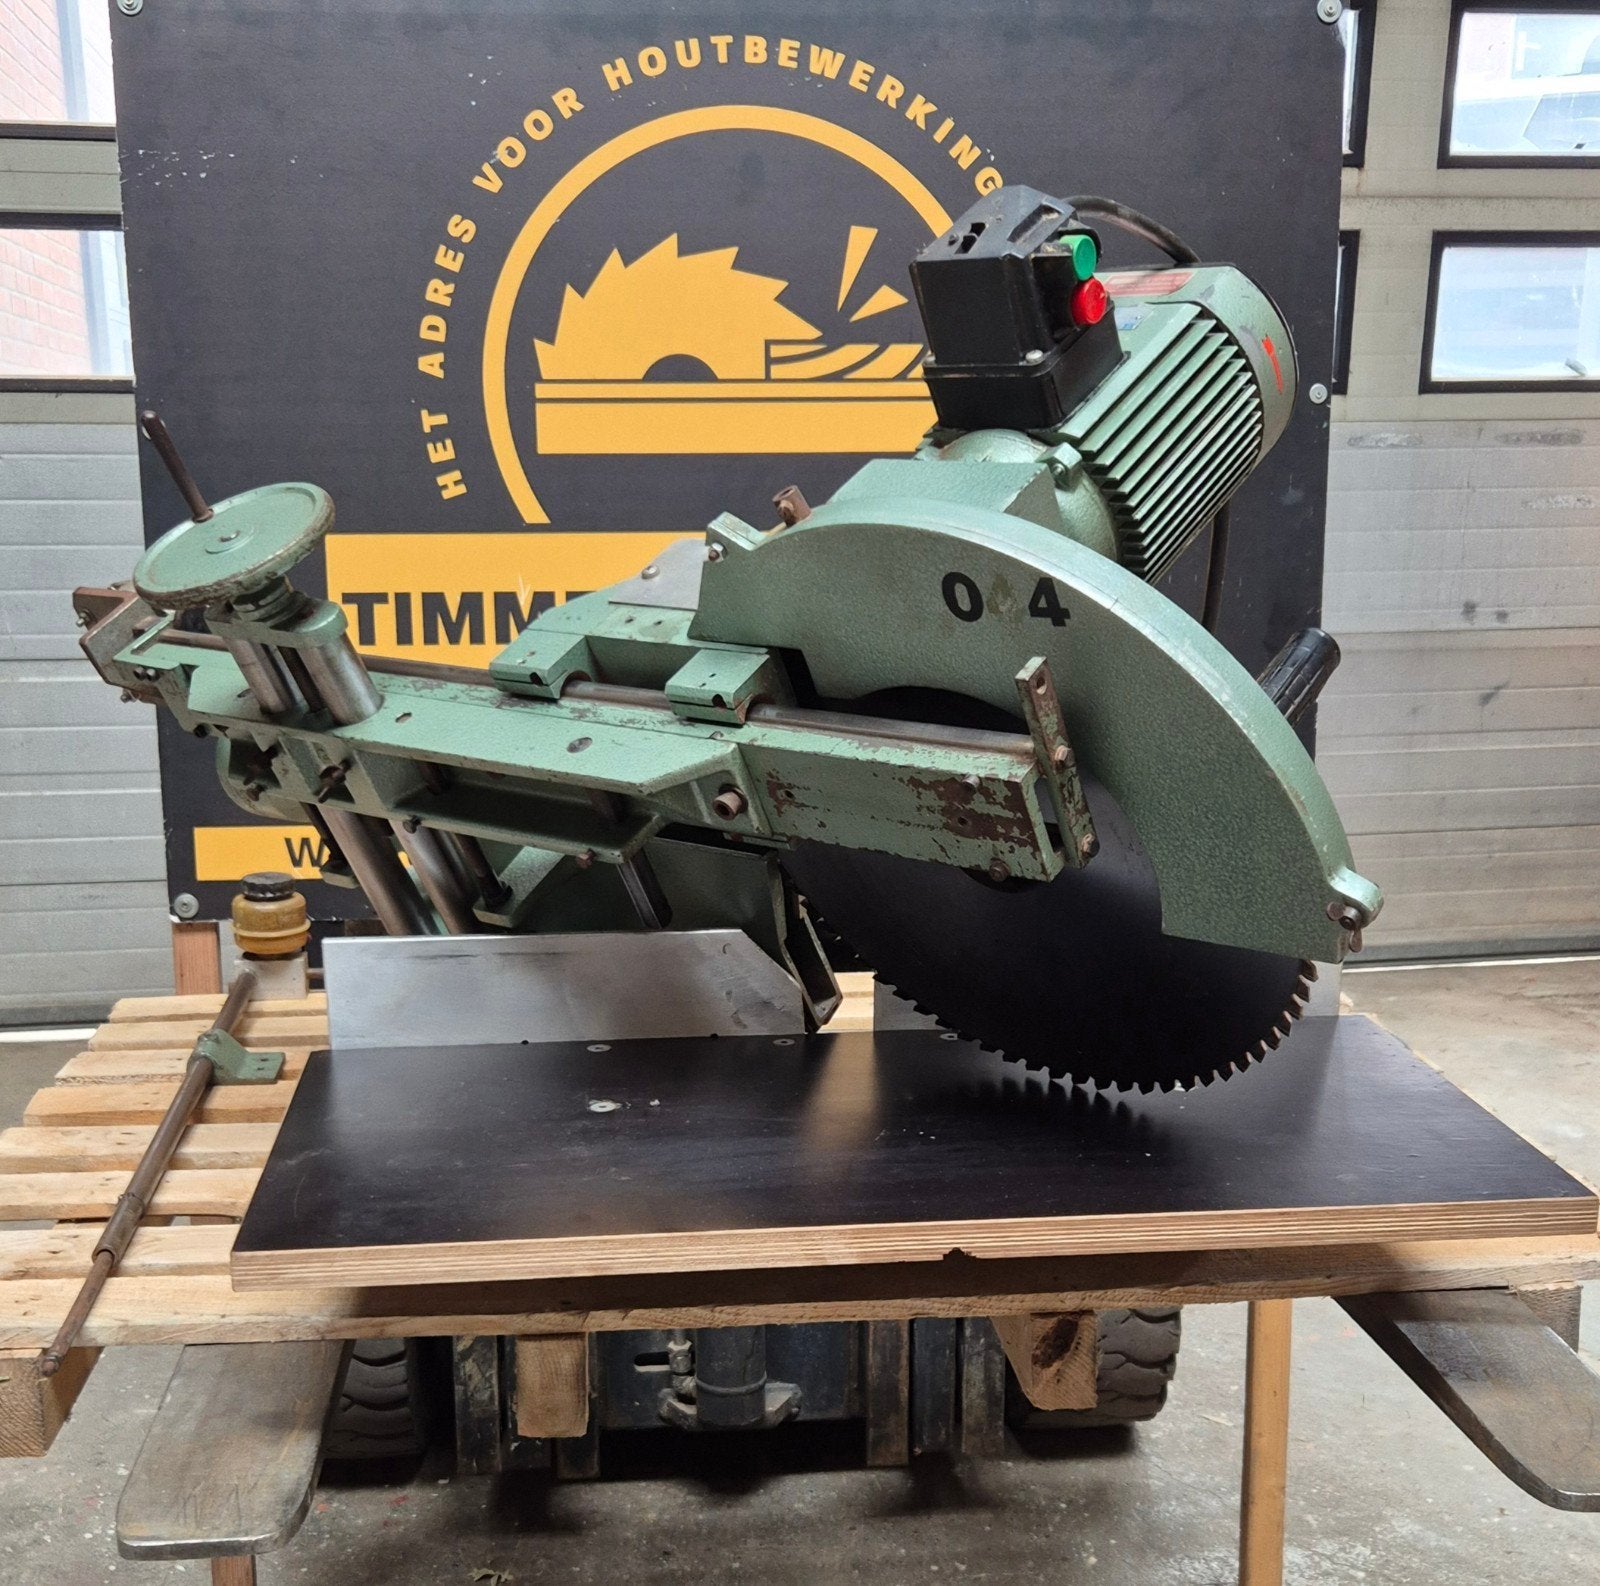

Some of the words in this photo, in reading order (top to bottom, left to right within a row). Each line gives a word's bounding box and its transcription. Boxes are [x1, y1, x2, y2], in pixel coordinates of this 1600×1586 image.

[472, 87, 584, 194] VOOR
[418, 214, 478, 379] ADRES
[420, 409, 467, 501] HET
[341, 590, 600, 647] TIMM
